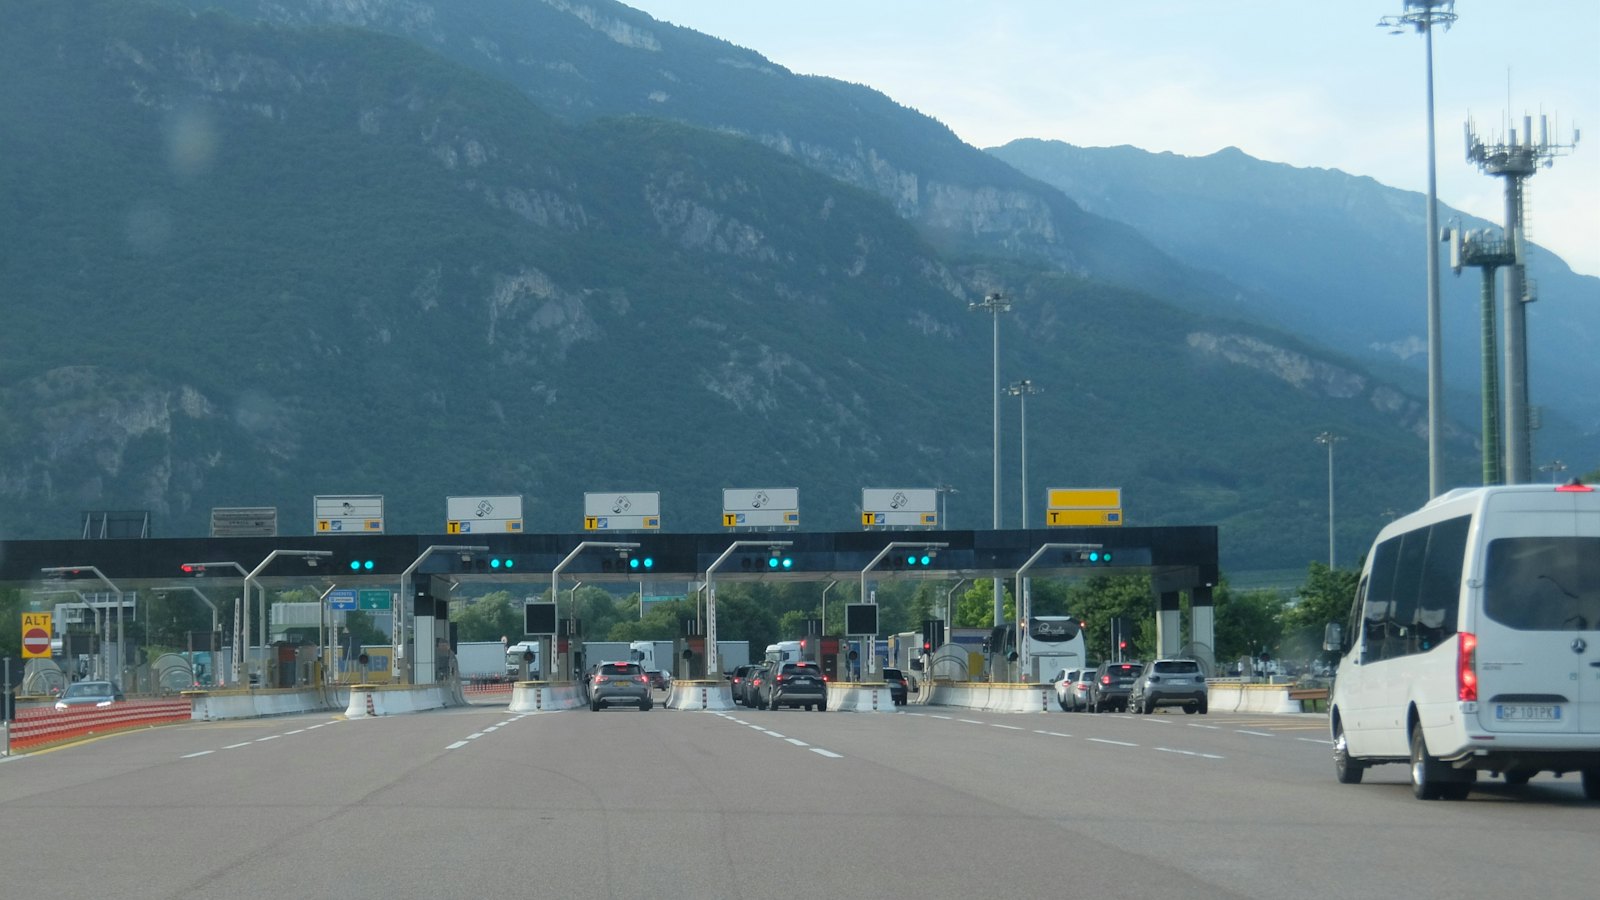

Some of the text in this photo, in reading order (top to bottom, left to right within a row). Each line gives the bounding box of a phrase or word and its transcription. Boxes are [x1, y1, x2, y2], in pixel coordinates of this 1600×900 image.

[725, 514, 734, 525] T
[864, 513, 873, 524] T
[1050, 512, 1059, 523] T
[319, 521, 327, 530] T
[449, 522, 458, 532] T
[586, 518, 595, 529] T
[25, 615, 49, 626] ALT
